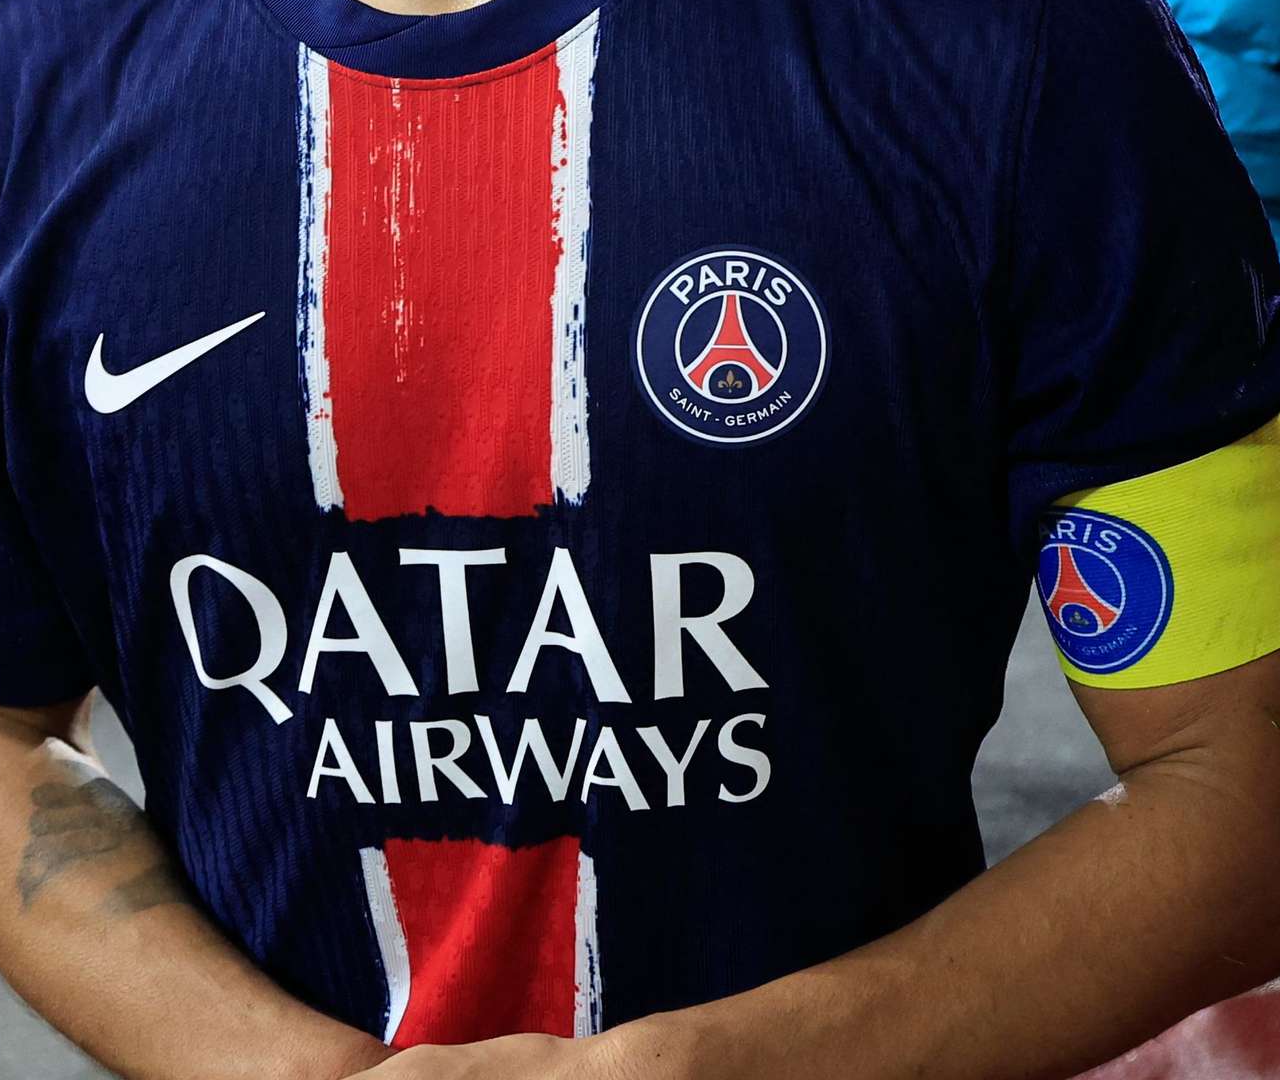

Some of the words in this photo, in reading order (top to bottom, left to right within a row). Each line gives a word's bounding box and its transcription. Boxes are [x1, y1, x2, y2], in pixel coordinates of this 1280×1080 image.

[669, 261, 793, 306] PARIS
[669, 388, 712, 422] SAINT
[725, 391, 792, 426] GERMAIN
[169, 546, 770, 725] QATAR
[306, 713, 772, 812] AIRWAYS
